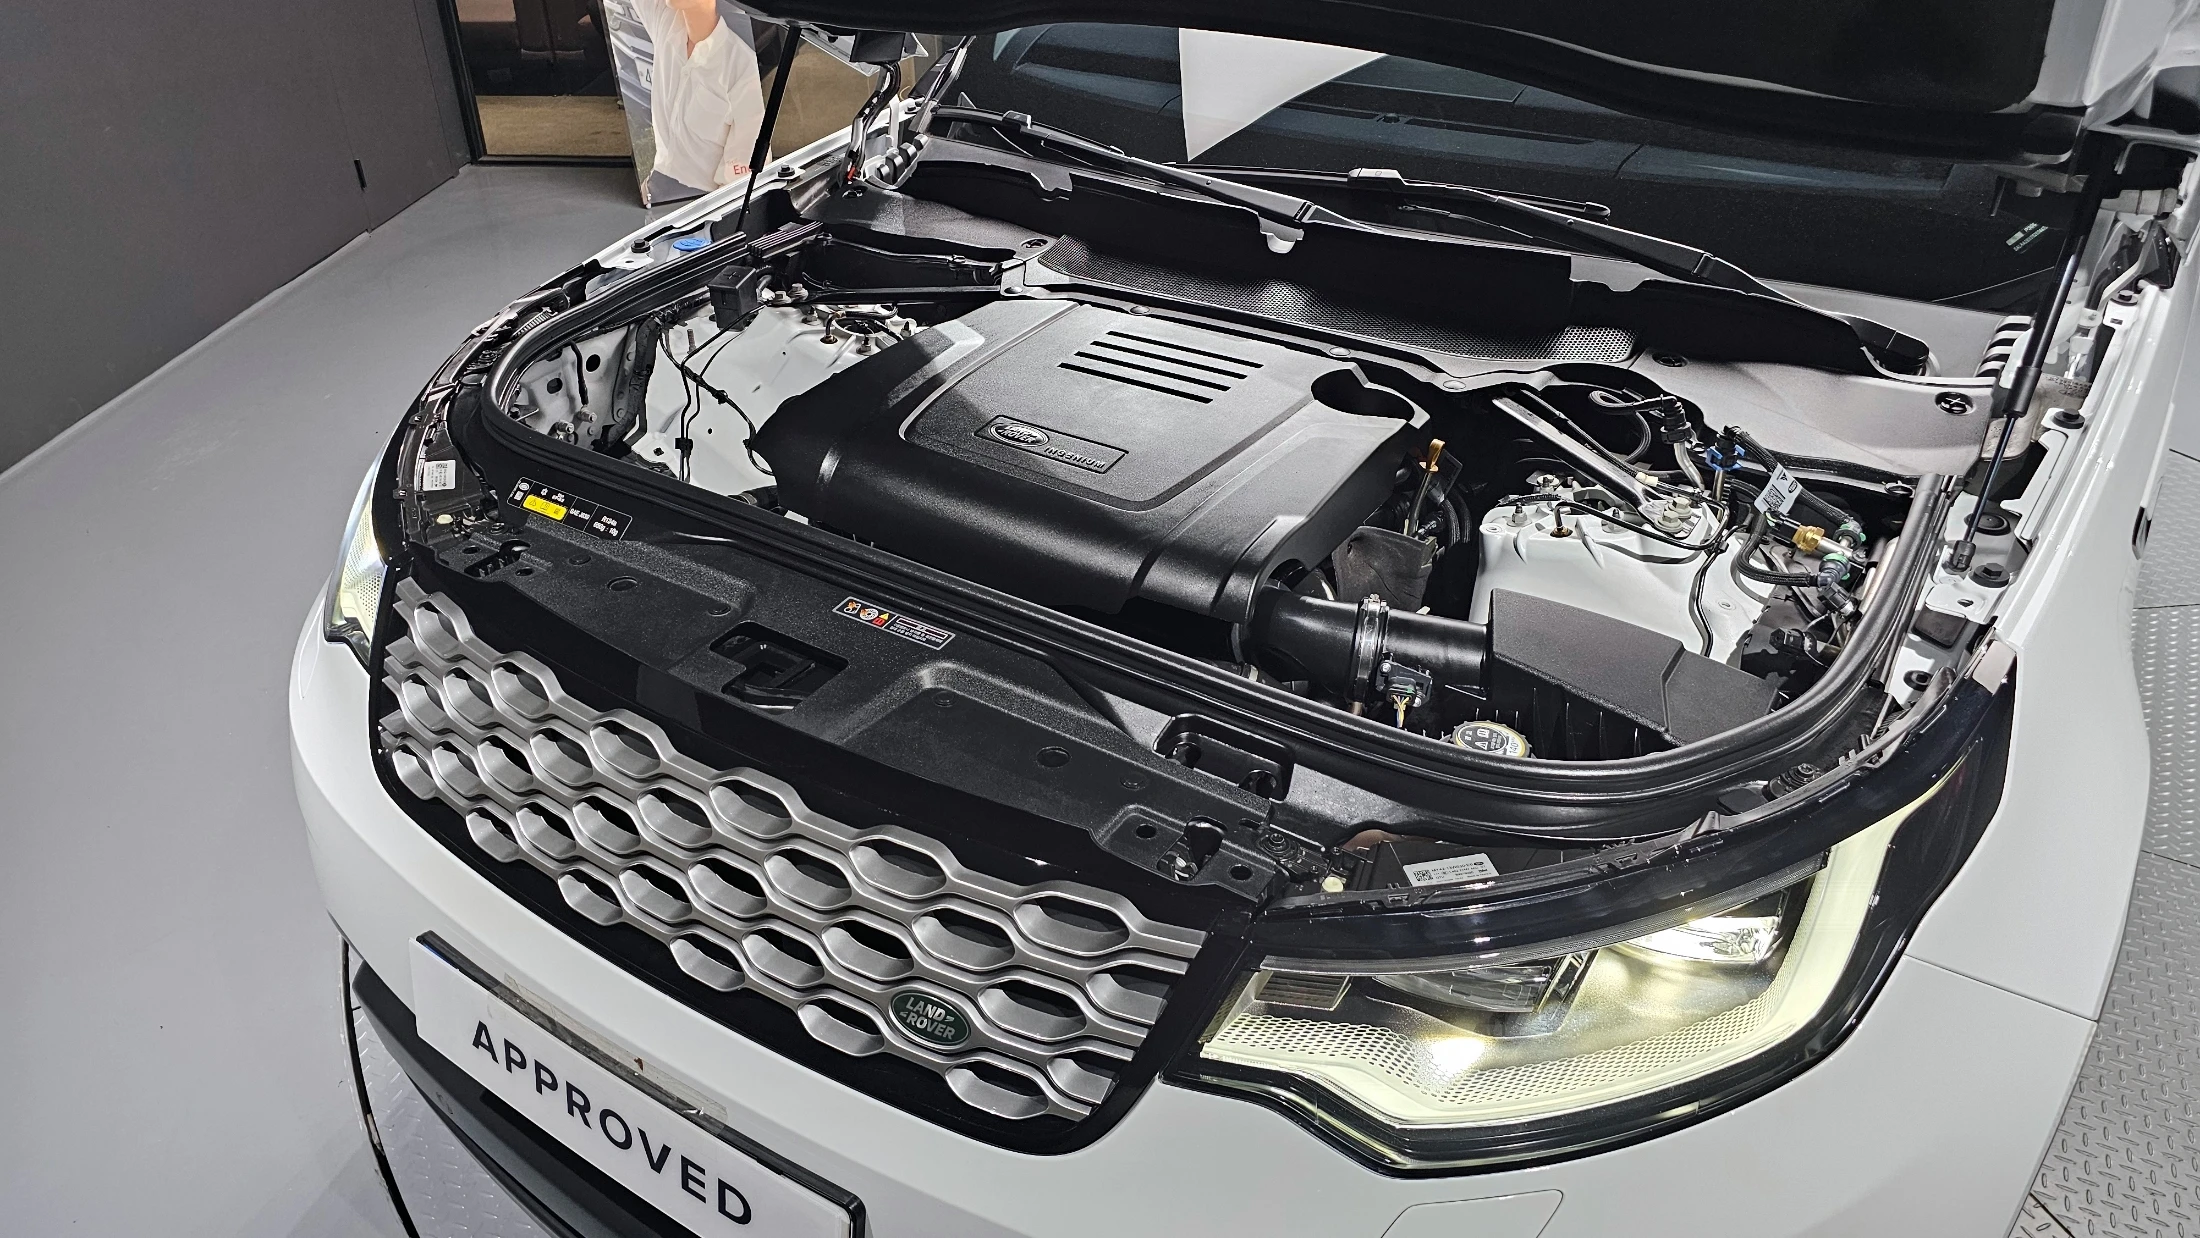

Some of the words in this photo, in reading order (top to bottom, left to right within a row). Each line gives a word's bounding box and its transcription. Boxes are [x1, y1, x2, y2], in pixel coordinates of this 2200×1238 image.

[1044, 446, 1106, 468] INGENIUM
[905, 996, 946, 1021] LAND
[905, 1011, 956, 1040] ROVER
[471, 1020, 752, 1225] APPROVED
